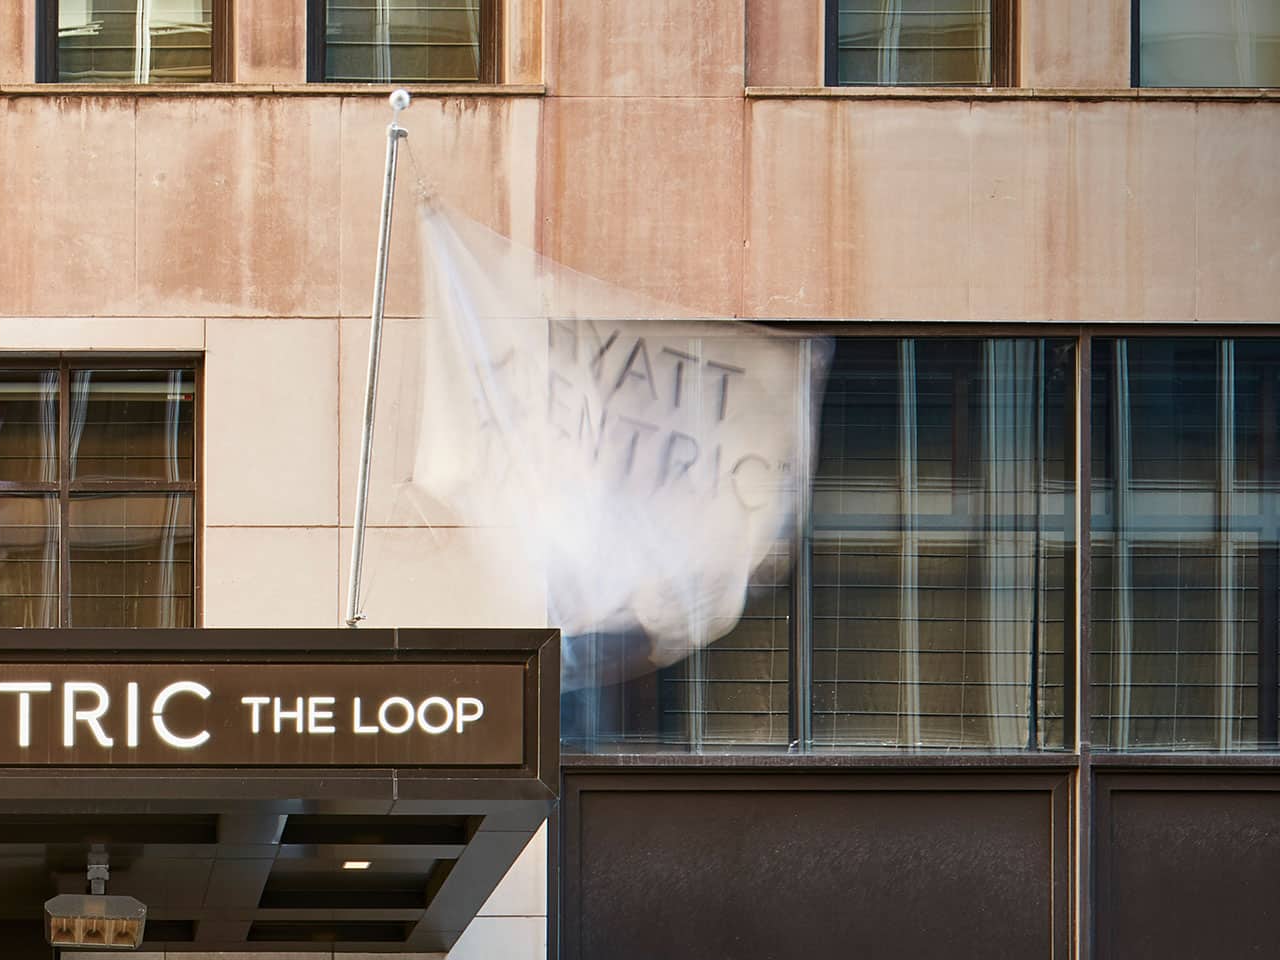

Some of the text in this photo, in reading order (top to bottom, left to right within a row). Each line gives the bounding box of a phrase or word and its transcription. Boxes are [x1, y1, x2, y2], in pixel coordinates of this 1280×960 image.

[548, 311, 746, 422] HYATT
[242, 696, 336, 734] THE
[353, 696, 484, 735] LOOP
